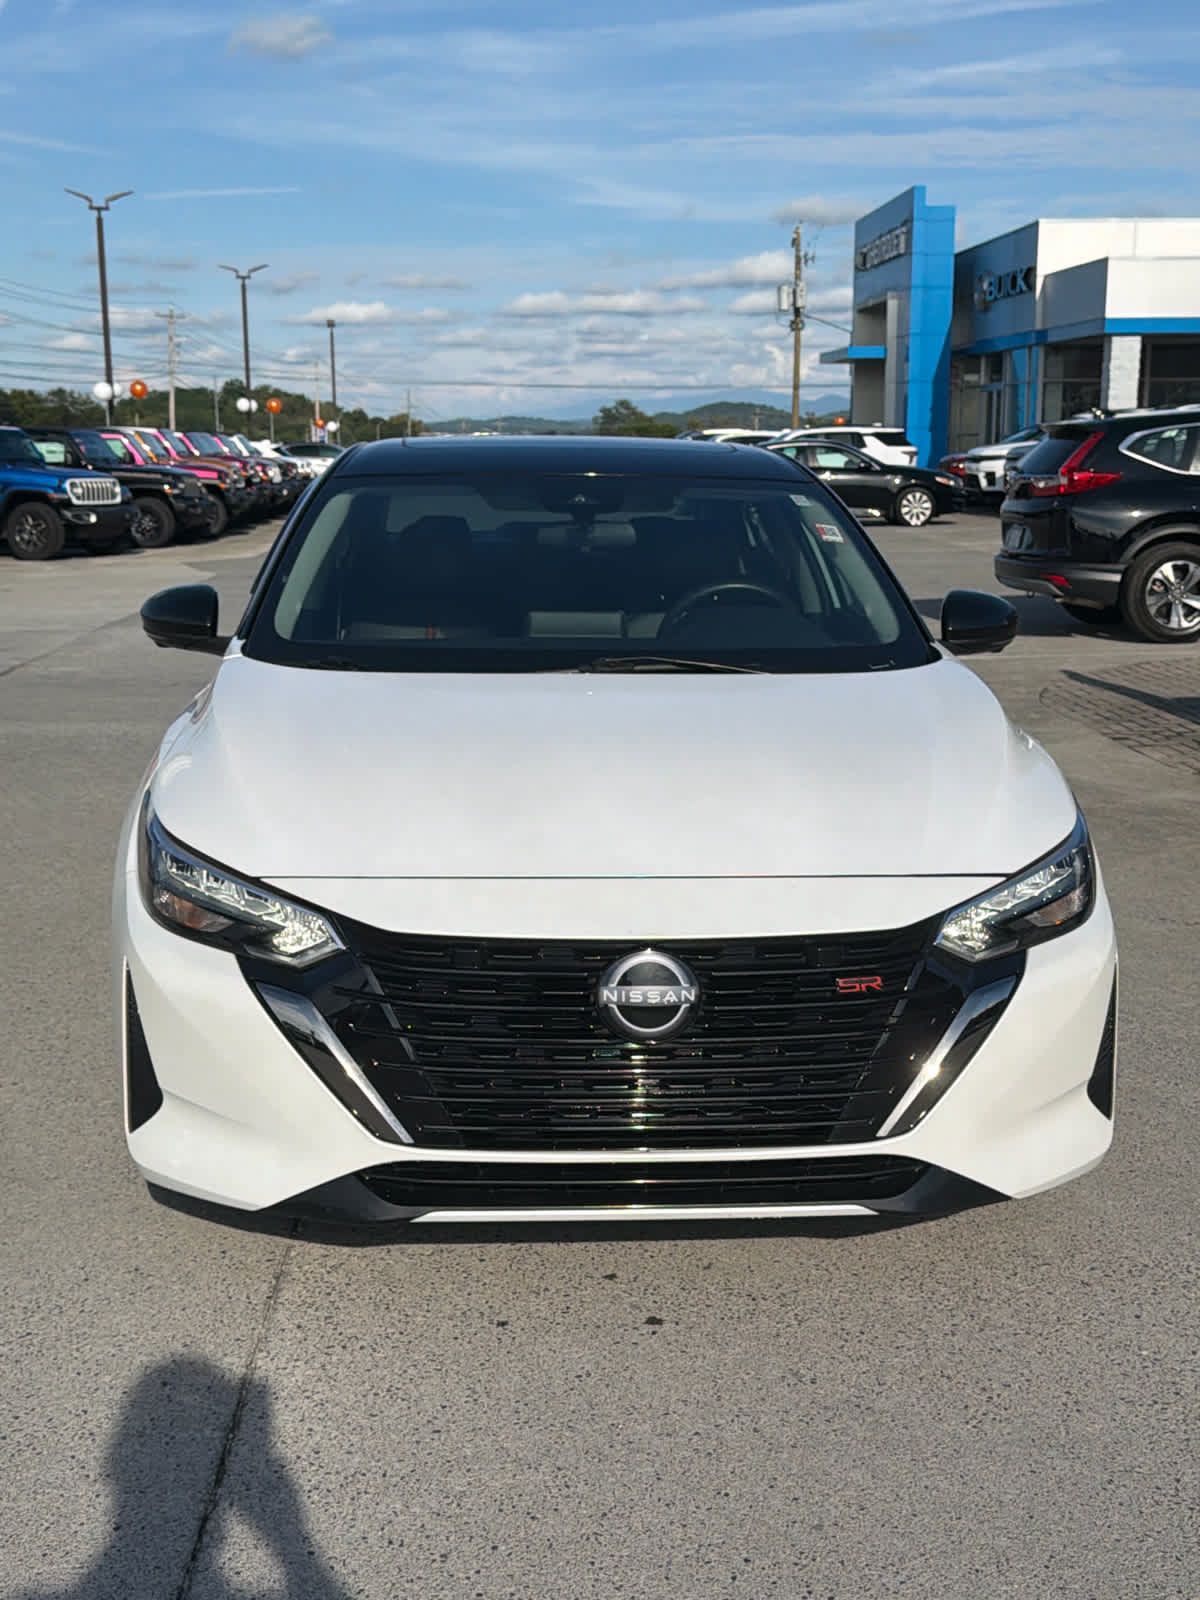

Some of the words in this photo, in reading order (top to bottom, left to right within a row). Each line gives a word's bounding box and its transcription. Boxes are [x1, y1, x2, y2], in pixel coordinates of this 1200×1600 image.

[984, 267, 1028, 301] BUICK
[837, 976, 882, 992] SR
[603, 989, 695, 1004] NISSAN
